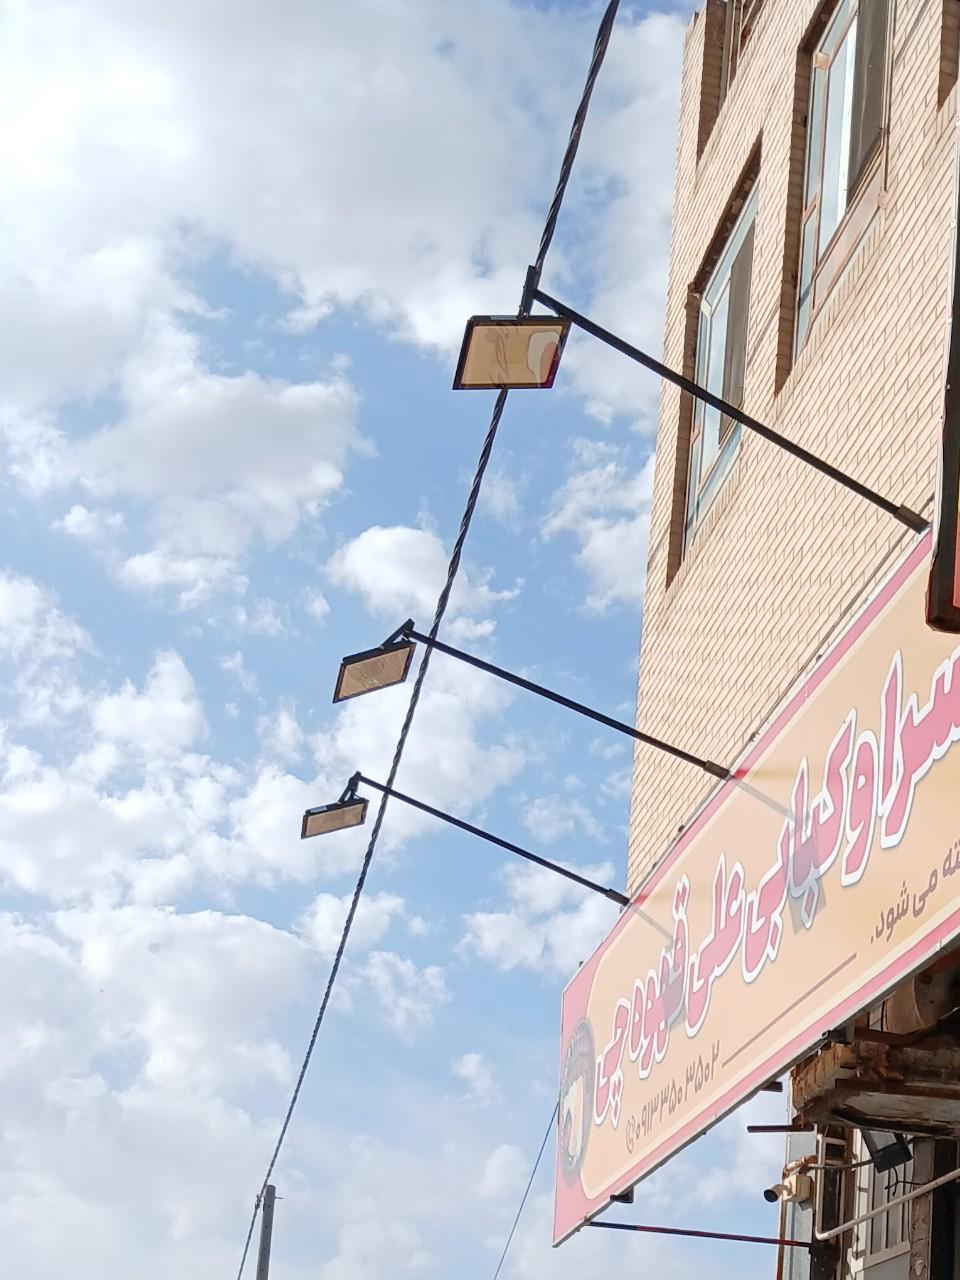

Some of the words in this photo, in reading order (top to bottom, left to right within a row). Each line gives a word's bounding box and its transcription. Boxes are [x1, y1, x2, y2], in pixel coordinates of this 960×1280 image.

[742, 706, 857, 983] کبابی
[841, 729, 879, 888] و
[685, 851, 745, 1037] علی
